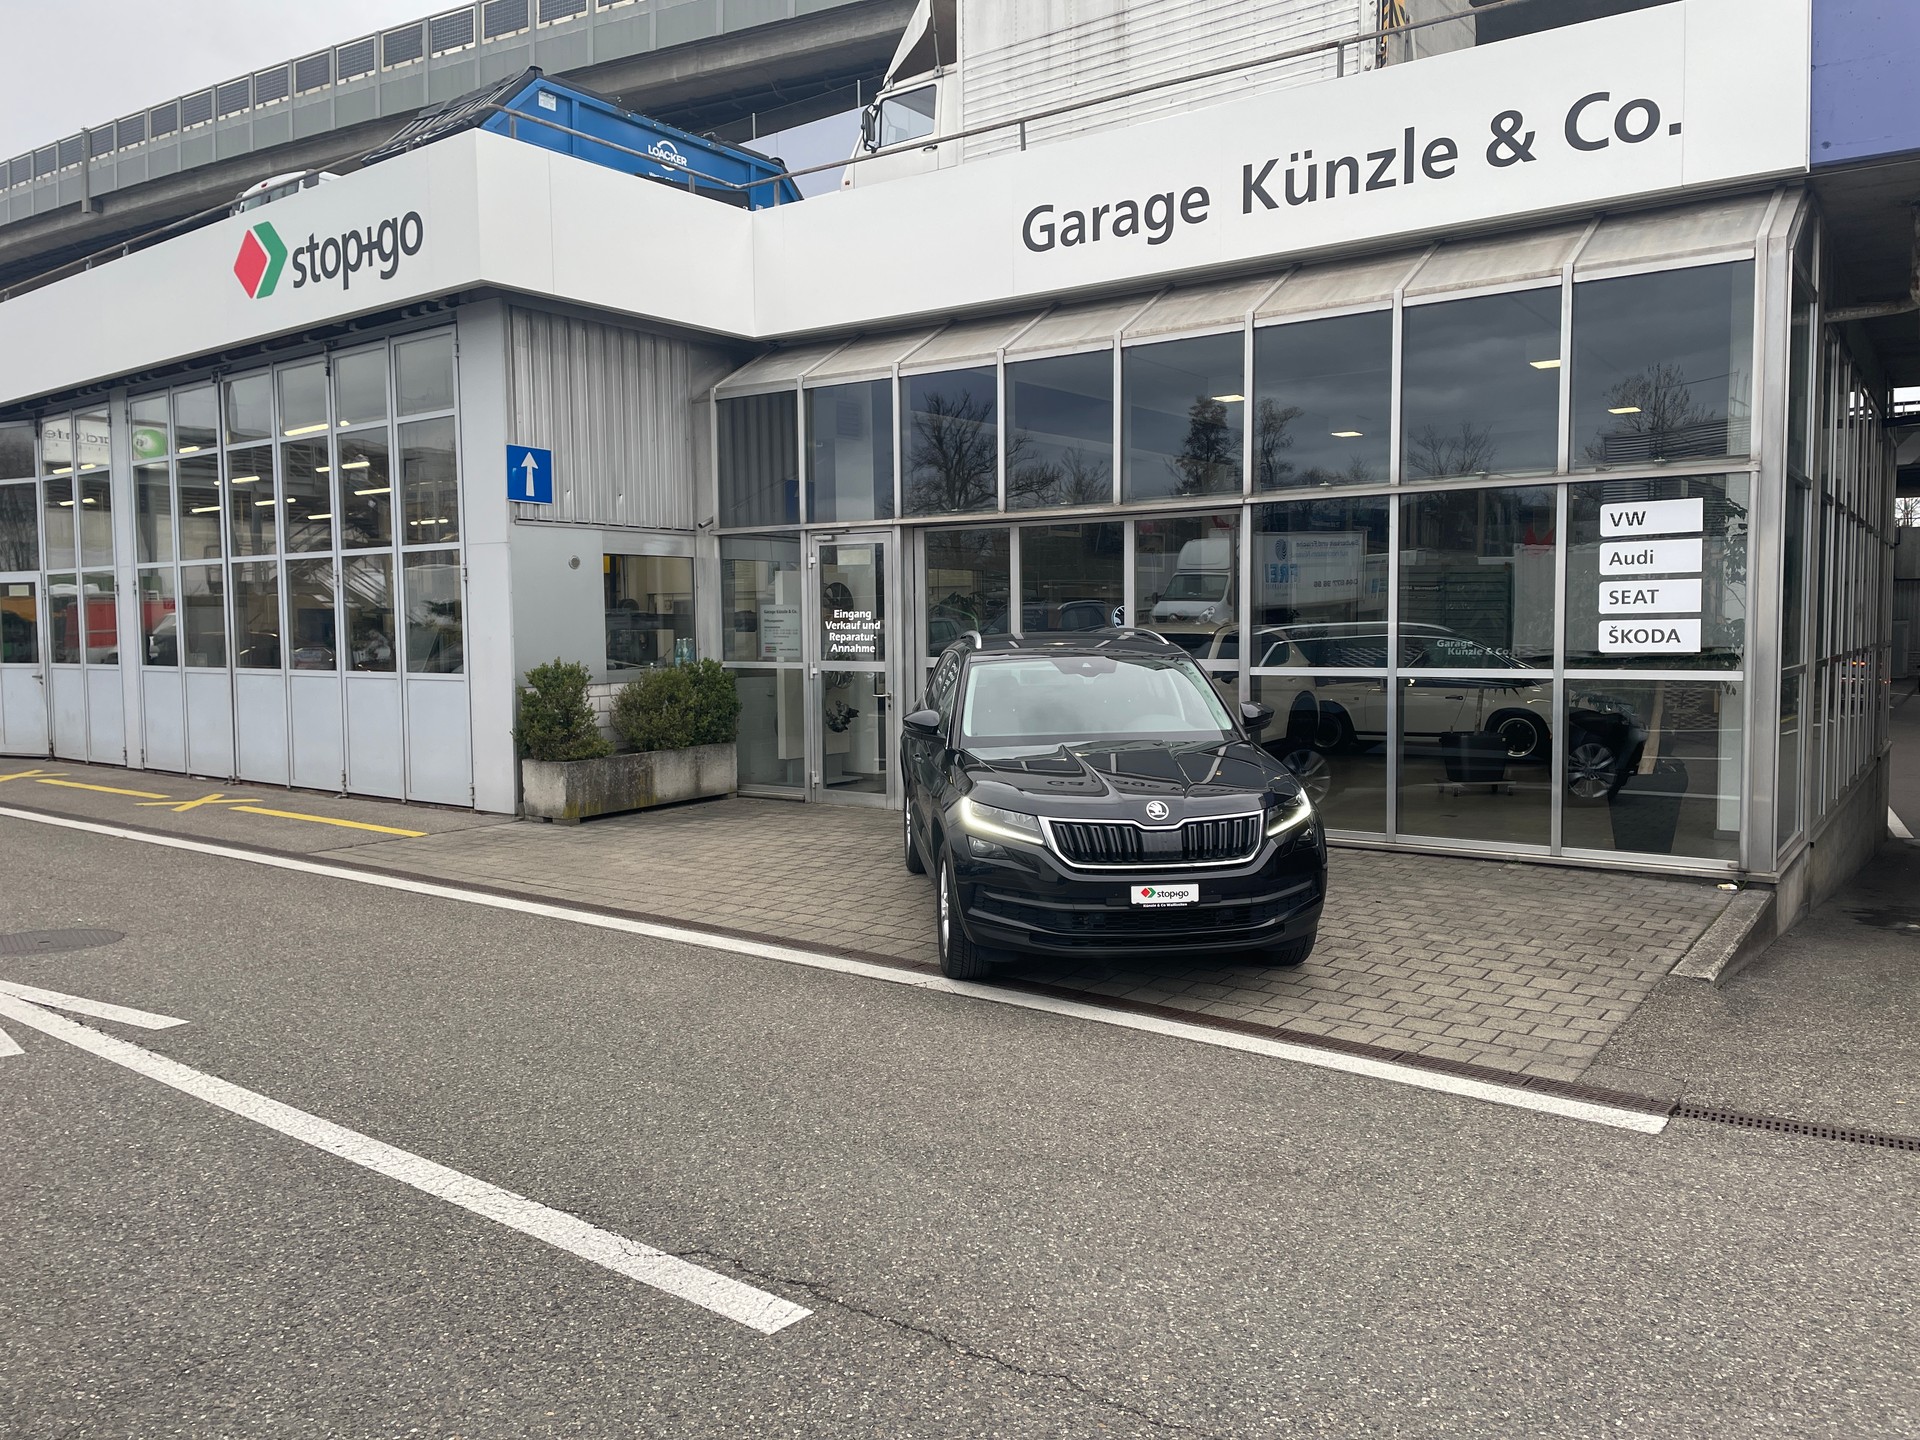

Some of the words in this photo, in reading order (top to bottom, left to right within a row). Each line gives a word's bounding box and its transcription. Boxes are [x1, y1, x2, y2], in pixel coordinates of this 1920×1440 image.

[647, 144, 688, 167] LOACKER
[1022, 186, 1210, 253] Garage
[1242, 126, 1459, 215] Künzle
[1485, 109, 1537, 168] &
[1564, 91, 1682, 152] Co.
[292, 211, 424, 291] stop+go
[1609, 511, 1647, 527] VW
[1608, 549, 1654, 566] Audi
[1608, 589, 1660, 605] SEAT
[833, 609, 872, 621] Eingang
[825, 621, 861, 630] Verkauf
[862, 620, 881, 630] und
[829, 632, 878, 644] Reparatur-
[1608, 625, 1682, 644] ŠKODA
[830, 643, 876, 653] Annahme
[1436, 639, 1473, 650] Garage
